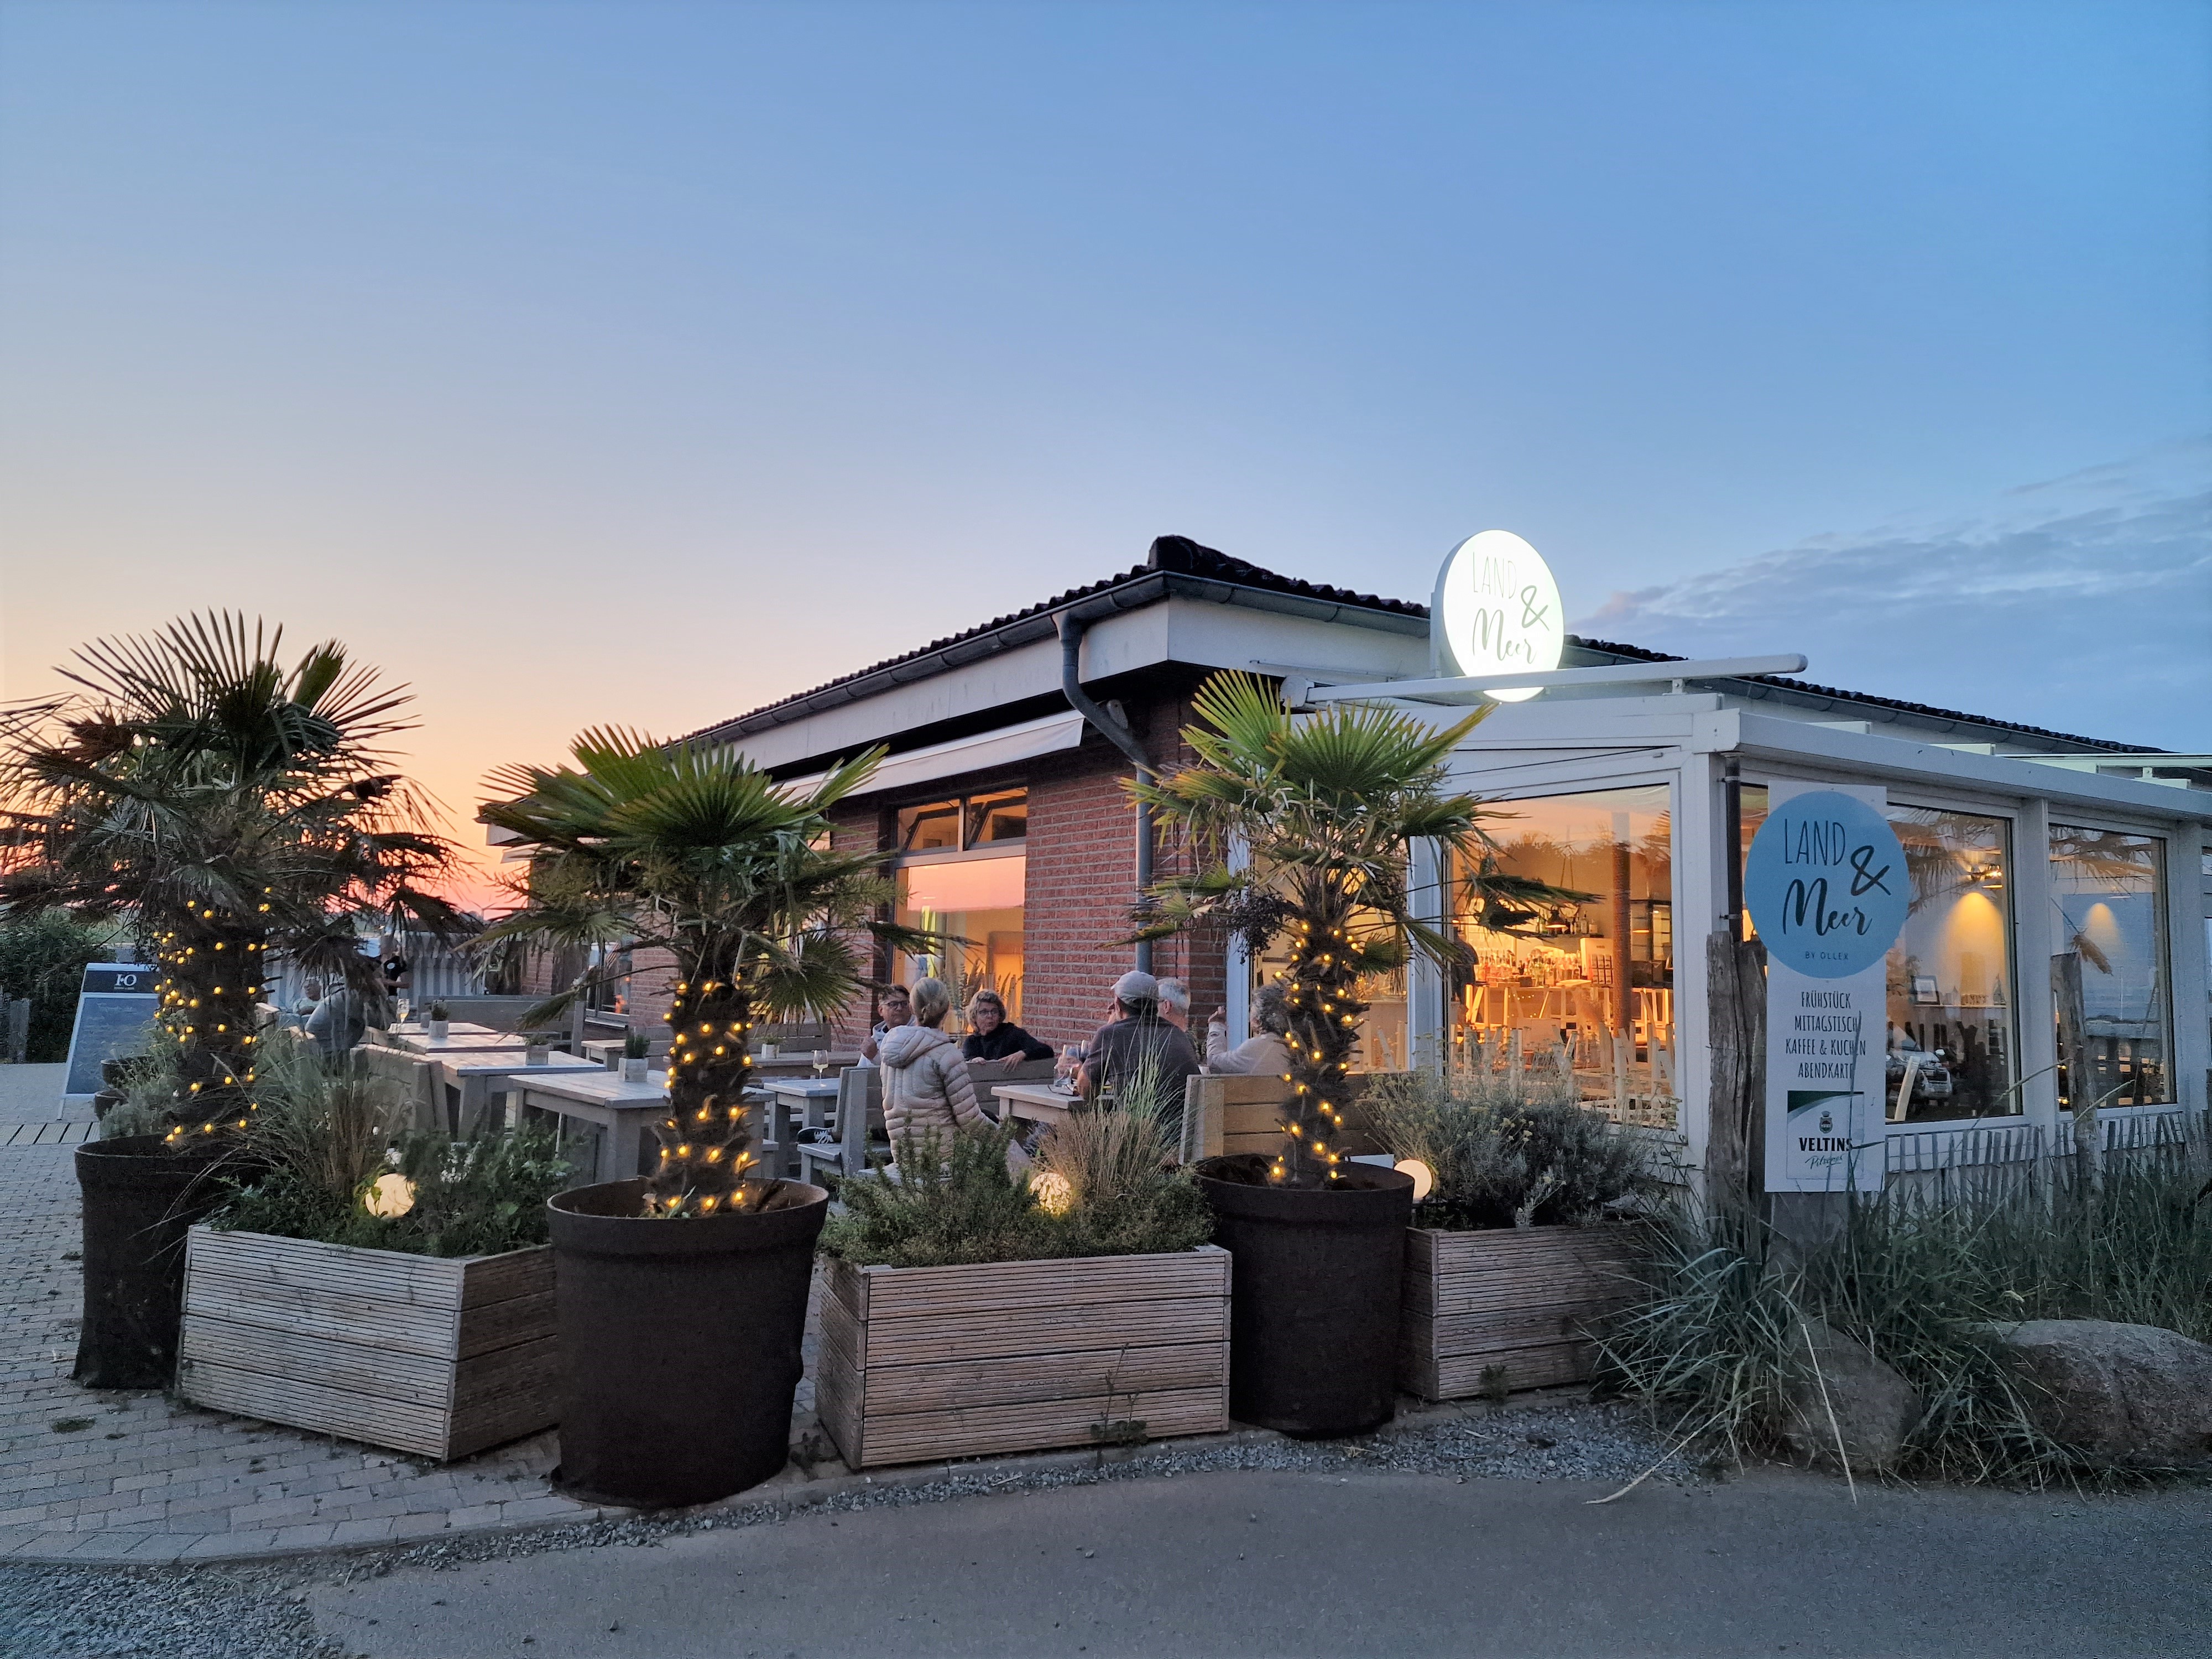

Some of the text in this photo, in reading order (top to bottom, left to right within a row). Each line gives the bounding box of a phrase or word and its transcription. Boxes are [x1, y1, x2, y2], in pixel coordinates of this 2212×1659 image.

[1473, 552, 1550, 631] LAND &
[1473, 608, 1537, 664] Meer
[1785, 818, 1891, 896] LAND &
[1782, 878, 1872, 936] Meer
[1801, 990, 1851, 1009] FRÜHSTÜCK
[1794, 1015, 1858, 1032] MITTAGSTISCH
[1786, 1038, 1866, 1056] KAFFEE & KUCHN
[1798, 1137, 1853, 1151] VELTINS
